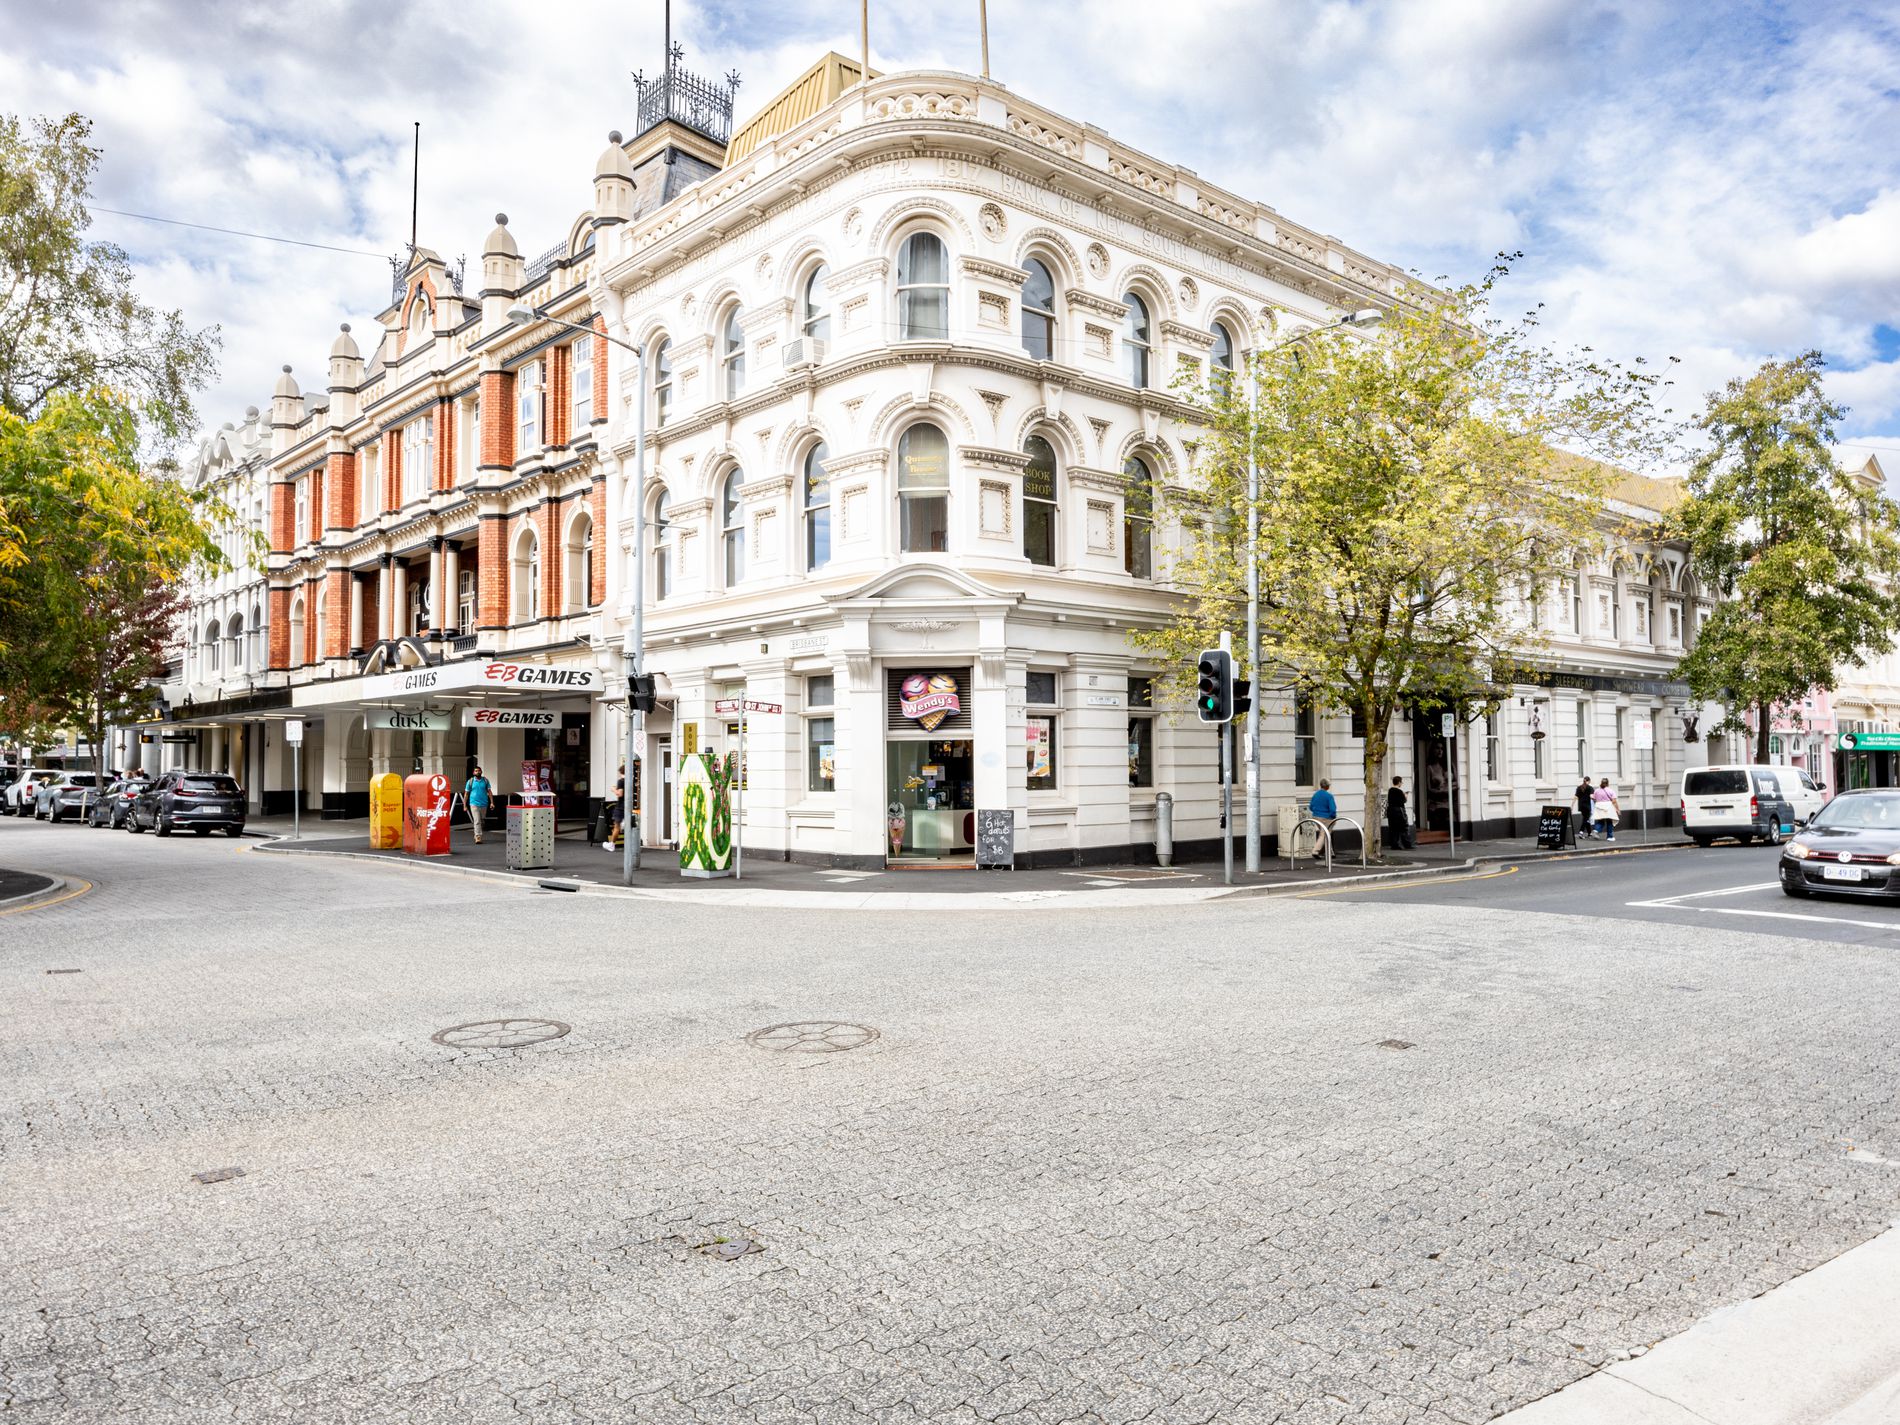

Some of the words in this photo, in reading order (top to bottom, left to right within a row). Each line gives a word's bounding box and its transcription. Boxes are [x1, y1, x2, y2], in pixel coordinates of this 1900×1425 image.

[937, 159, 981, 182] 1817
[1001, 172, 1048, 208] BANK
[1059, 196, 1082, 219] OF
[1095, 211, 1128, 238] NEW
[1142, 230, 1190, 264] SOUTH
[1025, 467, 1050, 482] BOOK
[1025, 482, 1052, 495] SHOP
[405, 671, 437, 690] GAMES
[484, 663, 519, 682] EB
[517, 668, 593, 686] GAMES
[1554, 674, 1593, 689] SLEEPWEAR
[1612, 680, 1644, 692] SWIMWEAR
[905, 696, 953, 713] Wendy's
[390, 712, 429, 729] dusk
[474, 709, 500, 724] EB
[498, 712, 554, 725] GAMES
[986, 818, 992, 829] 6
[992, 845, 1003, 855] $8
